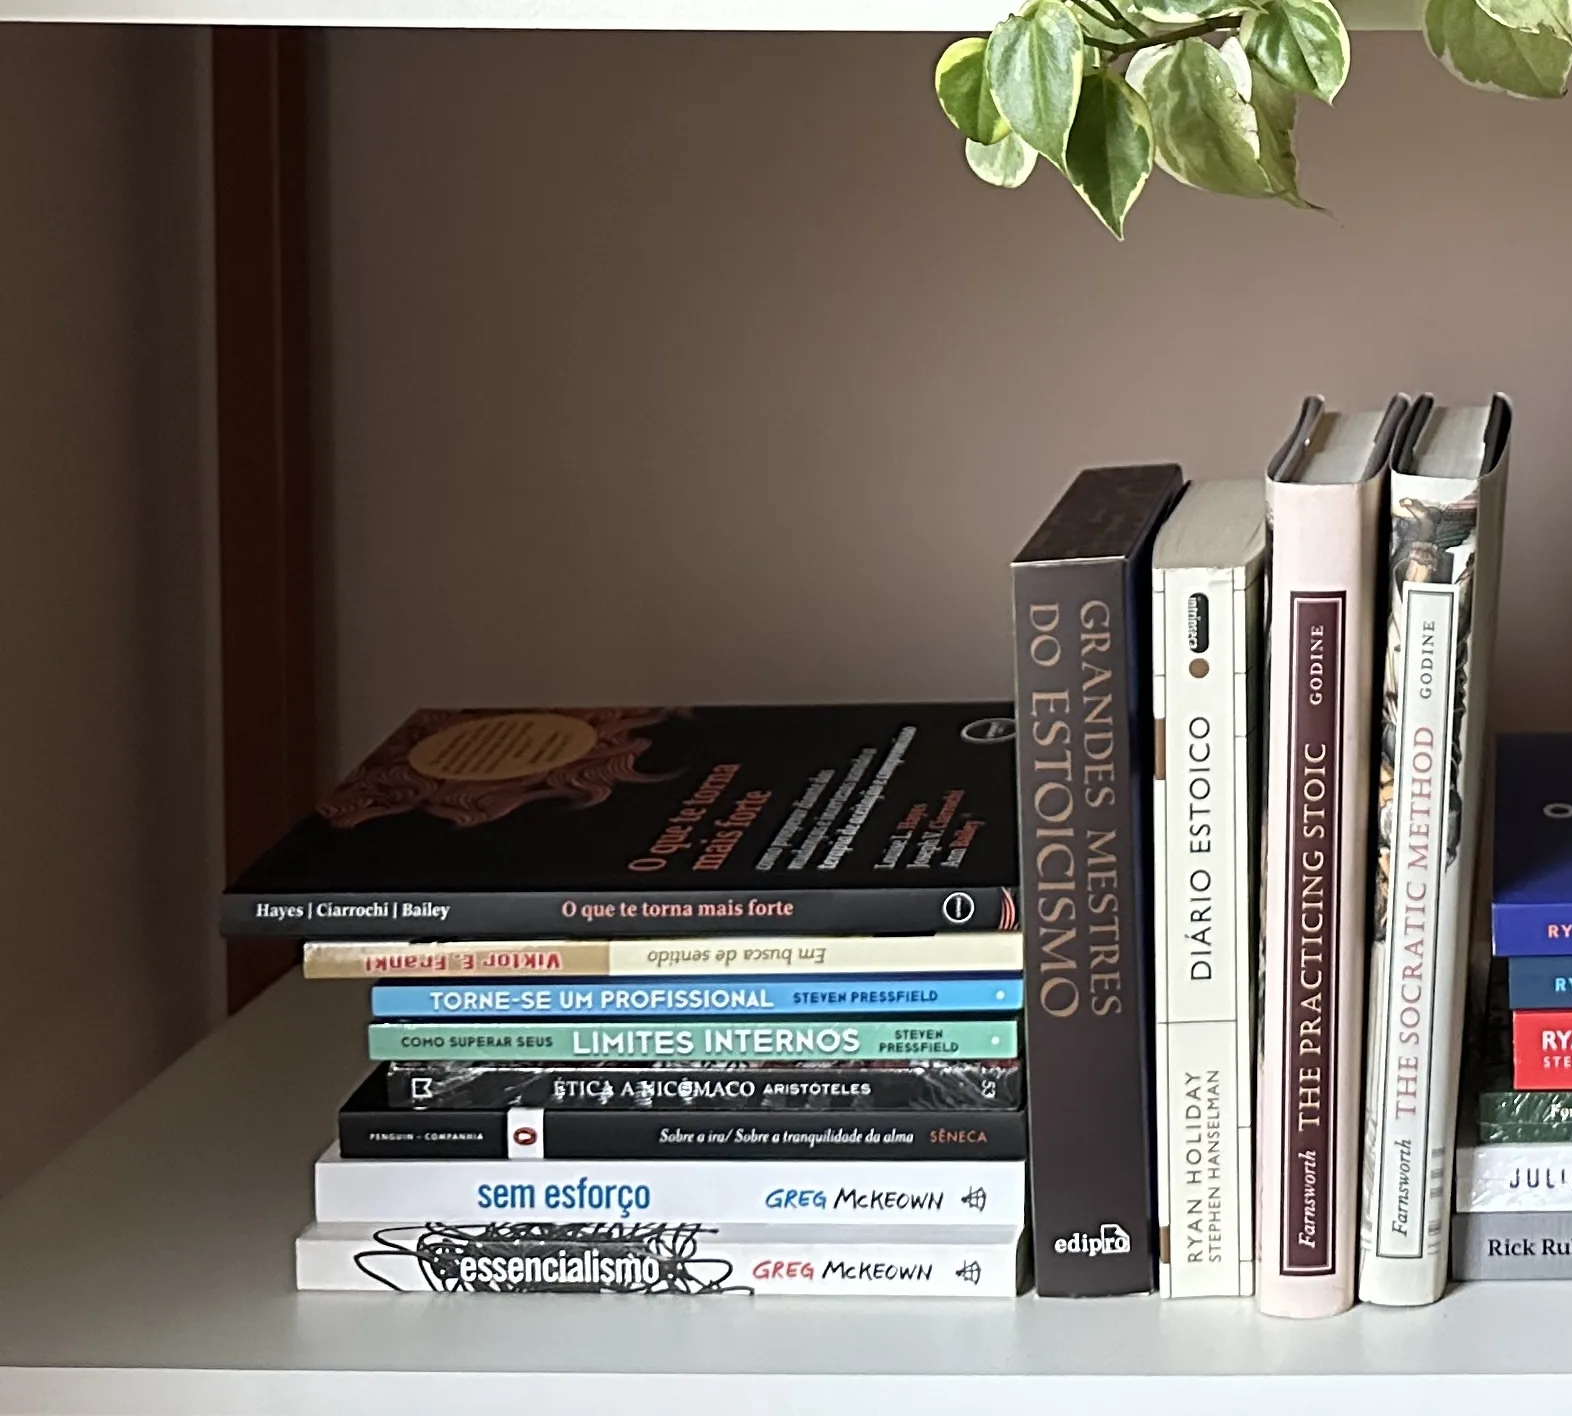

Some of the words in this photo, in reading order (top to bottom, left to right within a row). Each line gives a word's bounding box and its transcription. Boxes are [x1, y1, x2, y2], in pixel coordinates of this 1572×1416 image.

[1028, 601, 1062, 668] DO
[1308, 624, 1325, 706] GODINE
[1419, 619, 1436, 700] GODINE
[1079, 598, 1117, 808] GRANDES
[1188, 716, 1212, 853] ESTOICO
[1302, 742, 1327, 840] STOIC
[1406, 725, 1436, 872] METHOD
[714, 790, 773, 828] forte
[628, 857, 667, 872] O
[649, 825, 693, 854] que
[692, 830, 744, 870] mais
[1030, 689, 1081, 1019] ESTOICISMO
[255, 902, 305, 921] Hayes
[402, 901, 451, 921] Bailey
[580, 904, 616, 922] que
[642, 902, 693, 918] torna
[697, 900, 744, 917] mais
[748, 899, 794, 917] forte
[1085, 830, 1122, 1017] MESTRES
[1183, 868, 1213, 982] DIÁRIO
[363, 953, 448, 973] Frankl
[482, 950, 562, 970] Viktor
[647, 949, 711, 968] sentido
[744, 947, 792, 966] busca
[1299, 850, 1325, 1057] PRACTICING
[1398, 880, 1428, 1047] SOCRATIC
[429, 990, 551, 1011] TORNE-SE
[559, 991, 593, 1010] UM
[600, 988, 774, 1011] PROFISSIONAL
[572, 1029, 694, 1055] LIMITES
[704, 1027, 861, 1055] INTERNOS
[878, 1040, 959, 1053] PRESSFIELD
[894, 1028, 944, 1040] STEVEN
[620, 1081, 635, 1097] A
[762, 1080, 872, 1097] ARISTÓTELES
[1297, 1066, 1322, 1133] THE
[1395, 1055, 1420, 1122] THE
[424, 1132, 485, 1141] COMPANHIA
[783, 1129, 864, 1148] tranquilidade
[929, 1126, 988, 1144] SÊNECA
[1184, 1071, 1203, 1185] HOLIDAY
[1206, 1070, 1221, 1180] HANSELMAN
[477, 1183, 535, 1209] sem
[544, 1177, 652, 1218] esforço
[764, 1187, 827, 1210] GREG
[1054, 1224, 1131, 1258] edipro
[1187, 1199, 1204, 1264] RYAN
[1207, 1186, 1223, 1264] STEPHEN
[1487, 1238, 1537, 1258] Rick
[459, 1249, 661, 1285] essencialismo
[751, 1259, 815, 1281] GREG
